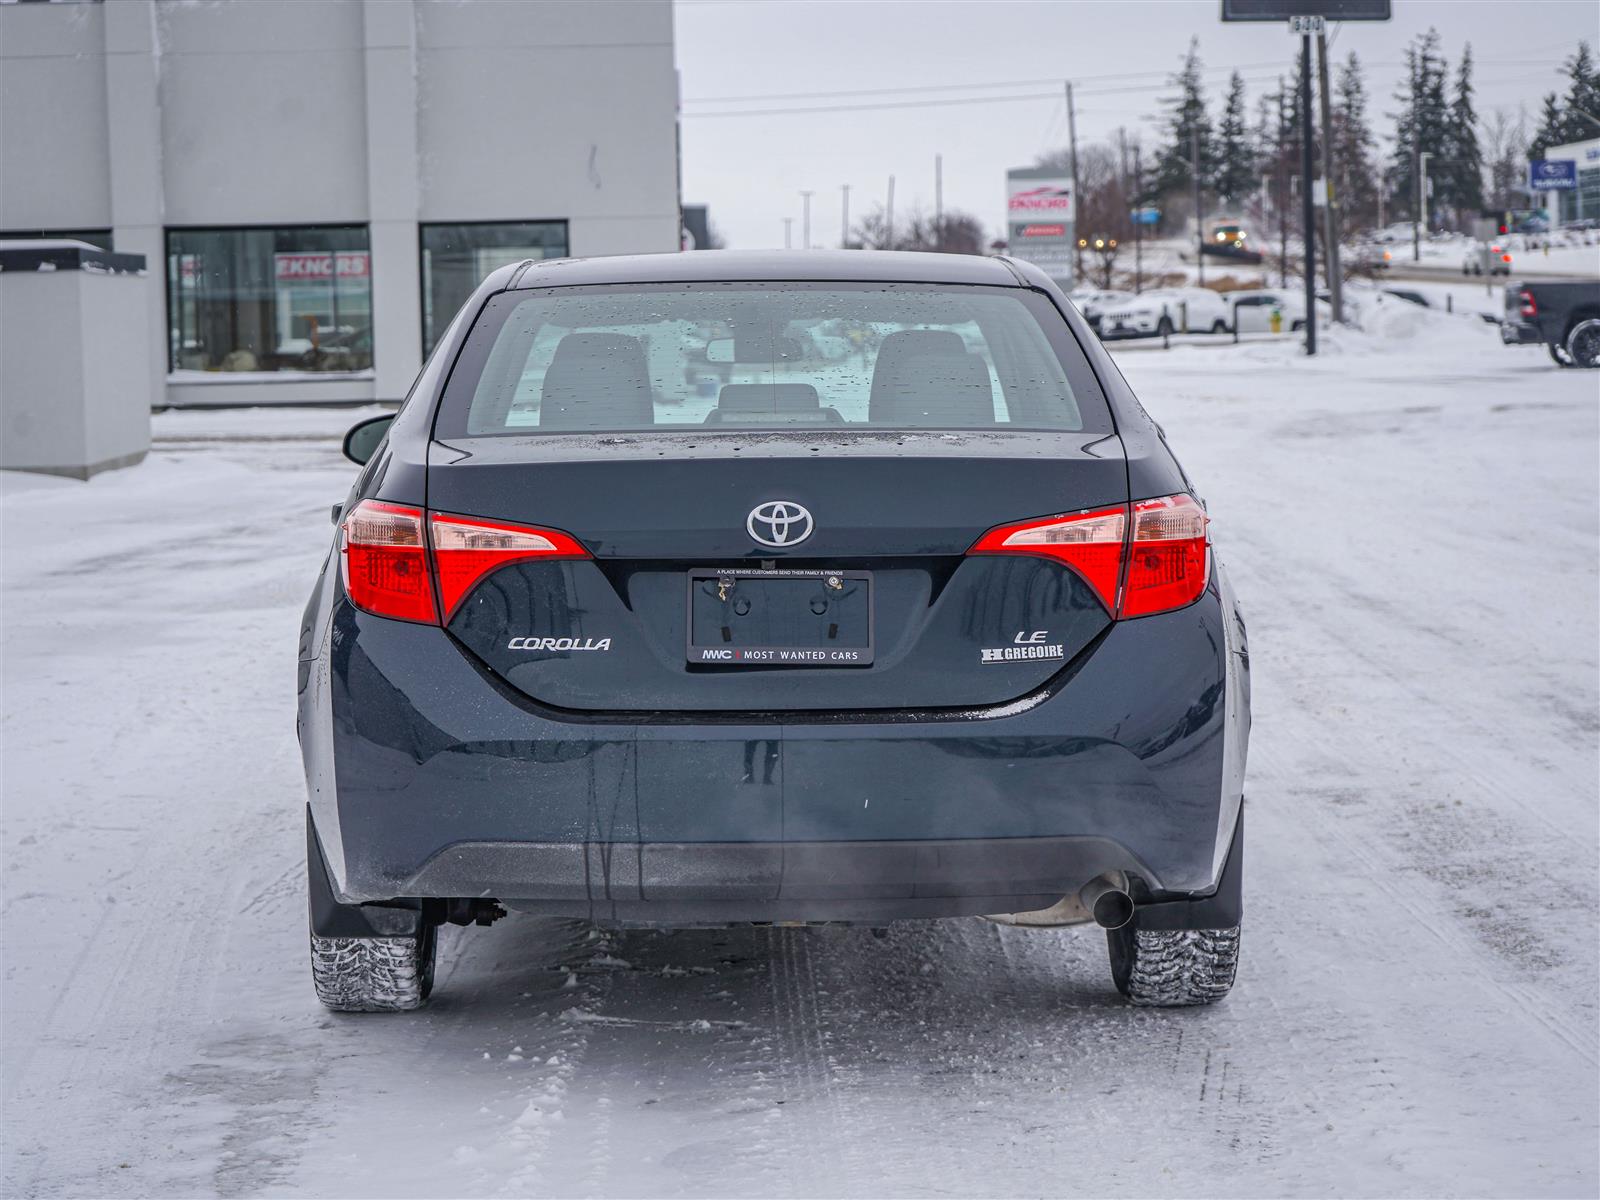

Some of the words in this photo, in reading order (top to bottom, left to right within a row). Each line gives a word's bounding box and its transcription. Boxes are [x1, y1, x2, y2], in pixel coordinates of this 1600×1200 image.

[1014, 631, 1048, 643] LE
[508, 637, 611, 651] COROLLA
[702, 650, 732, 659] MWC
[744, 651, 774, 659] MOST
[780, 651, 826, 660] WANTED
[831, 651, 858, 660] CARS
